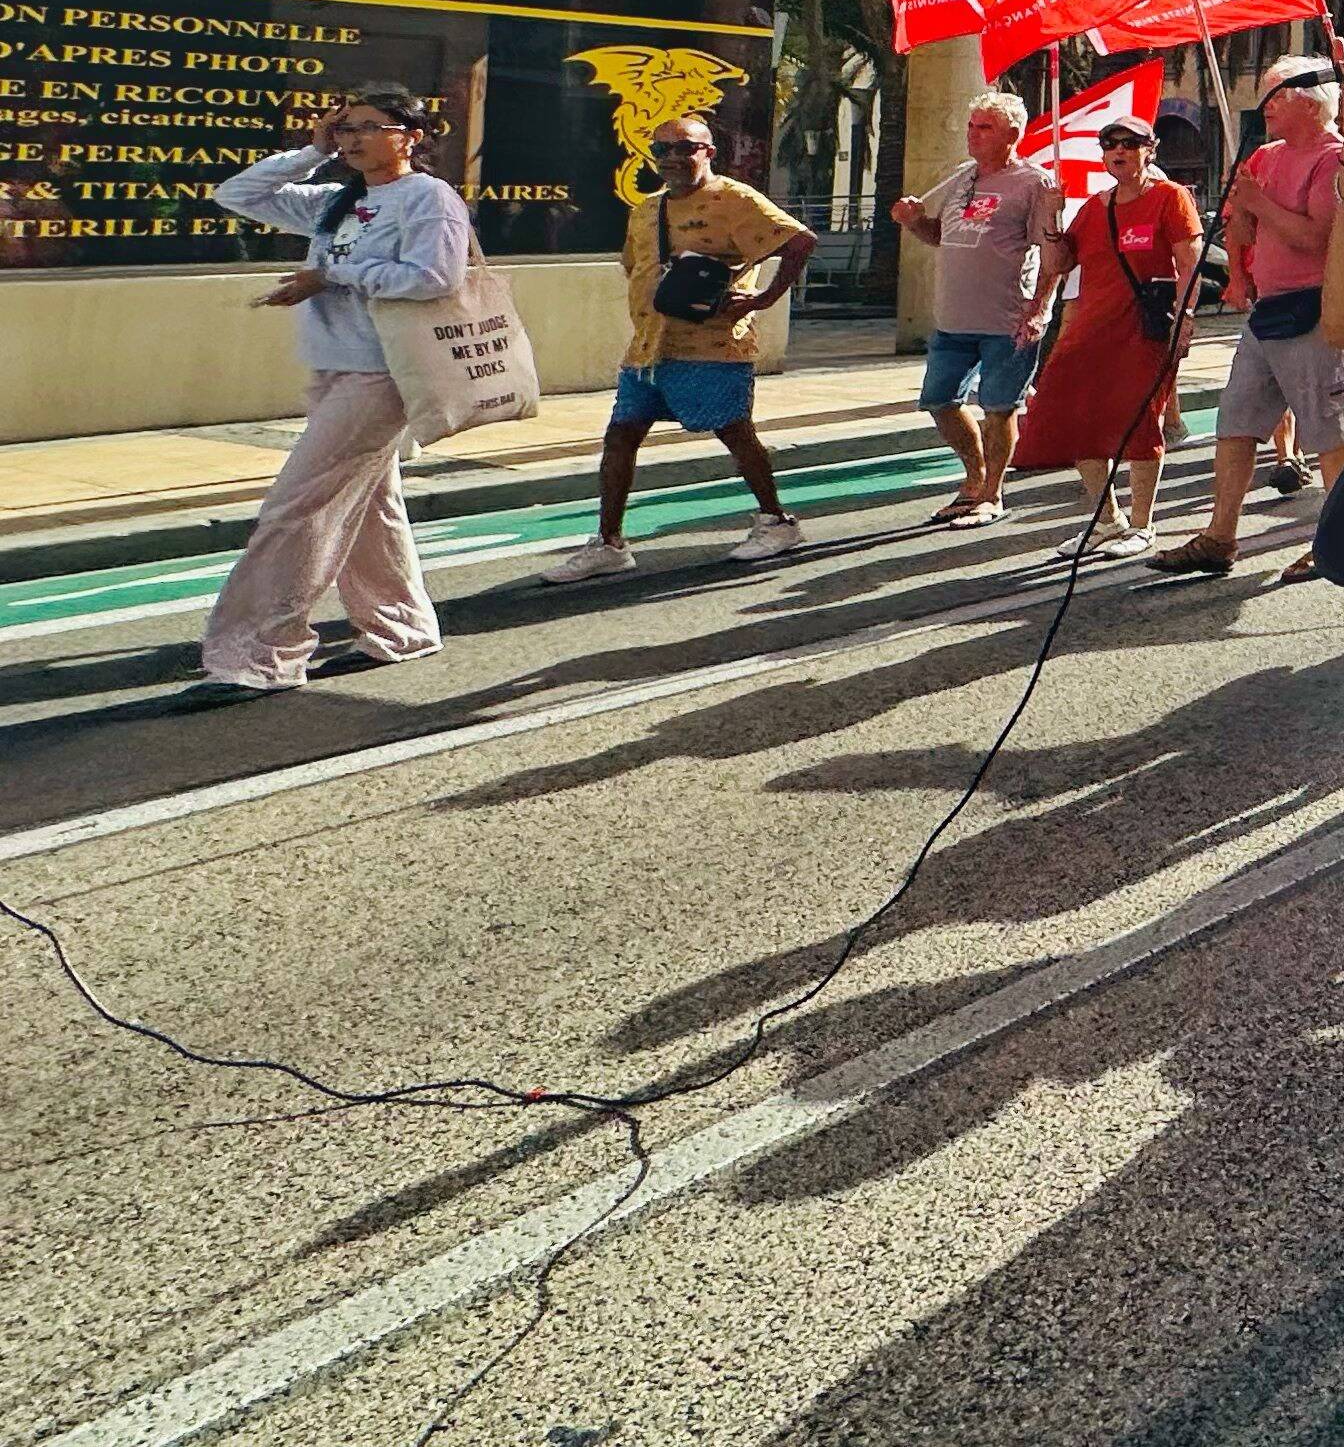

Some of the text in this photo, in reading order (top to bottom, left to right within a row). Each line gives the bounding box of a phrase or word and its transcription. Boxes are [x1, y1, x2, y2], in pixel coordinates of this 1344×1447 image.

[61, 8, 361, 45] PERSONNELLE
[184, 52, 324, 75] PHOTO
[39, 80, 102, 101] EN
[100, 109, 274, 131] cicatrices,
[25, 181, 62, 200] &
[434, 315, 508, 340] DON'T JUDGE
[451, 336, 509, 360] ME BY MY
[466, 360, 506, 380] LOOKS
